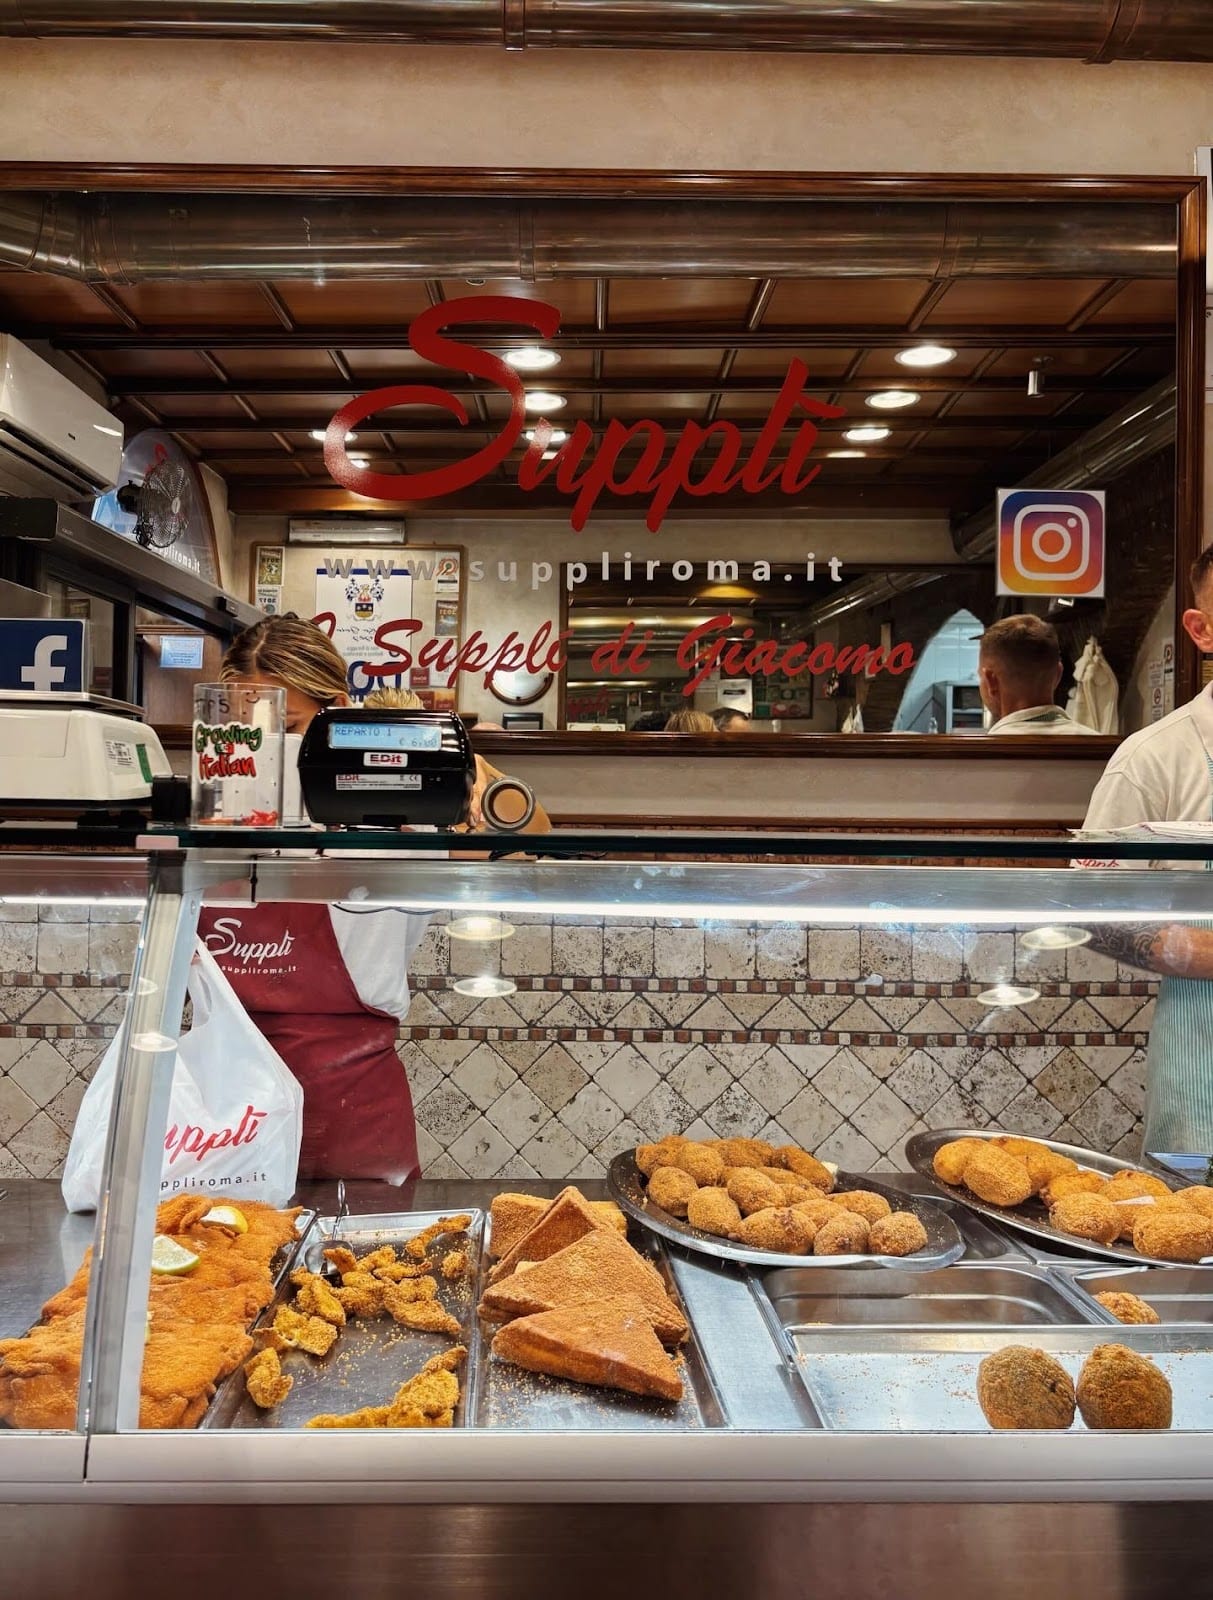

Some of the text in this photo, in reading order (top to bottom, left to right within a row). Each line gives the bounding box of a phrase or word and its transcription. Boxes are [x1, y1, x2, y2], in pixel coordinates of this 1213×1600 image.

[591, 621, 655, 675] di
[676, 614, 916, 697] Giacomo
[195, 723, 262, 752] Growing
[335, 727, 392, 737] REPARTO 1
[199, 752, 256, 779] Italian
[160, 1172, 266, 1190] ppliroma.it
